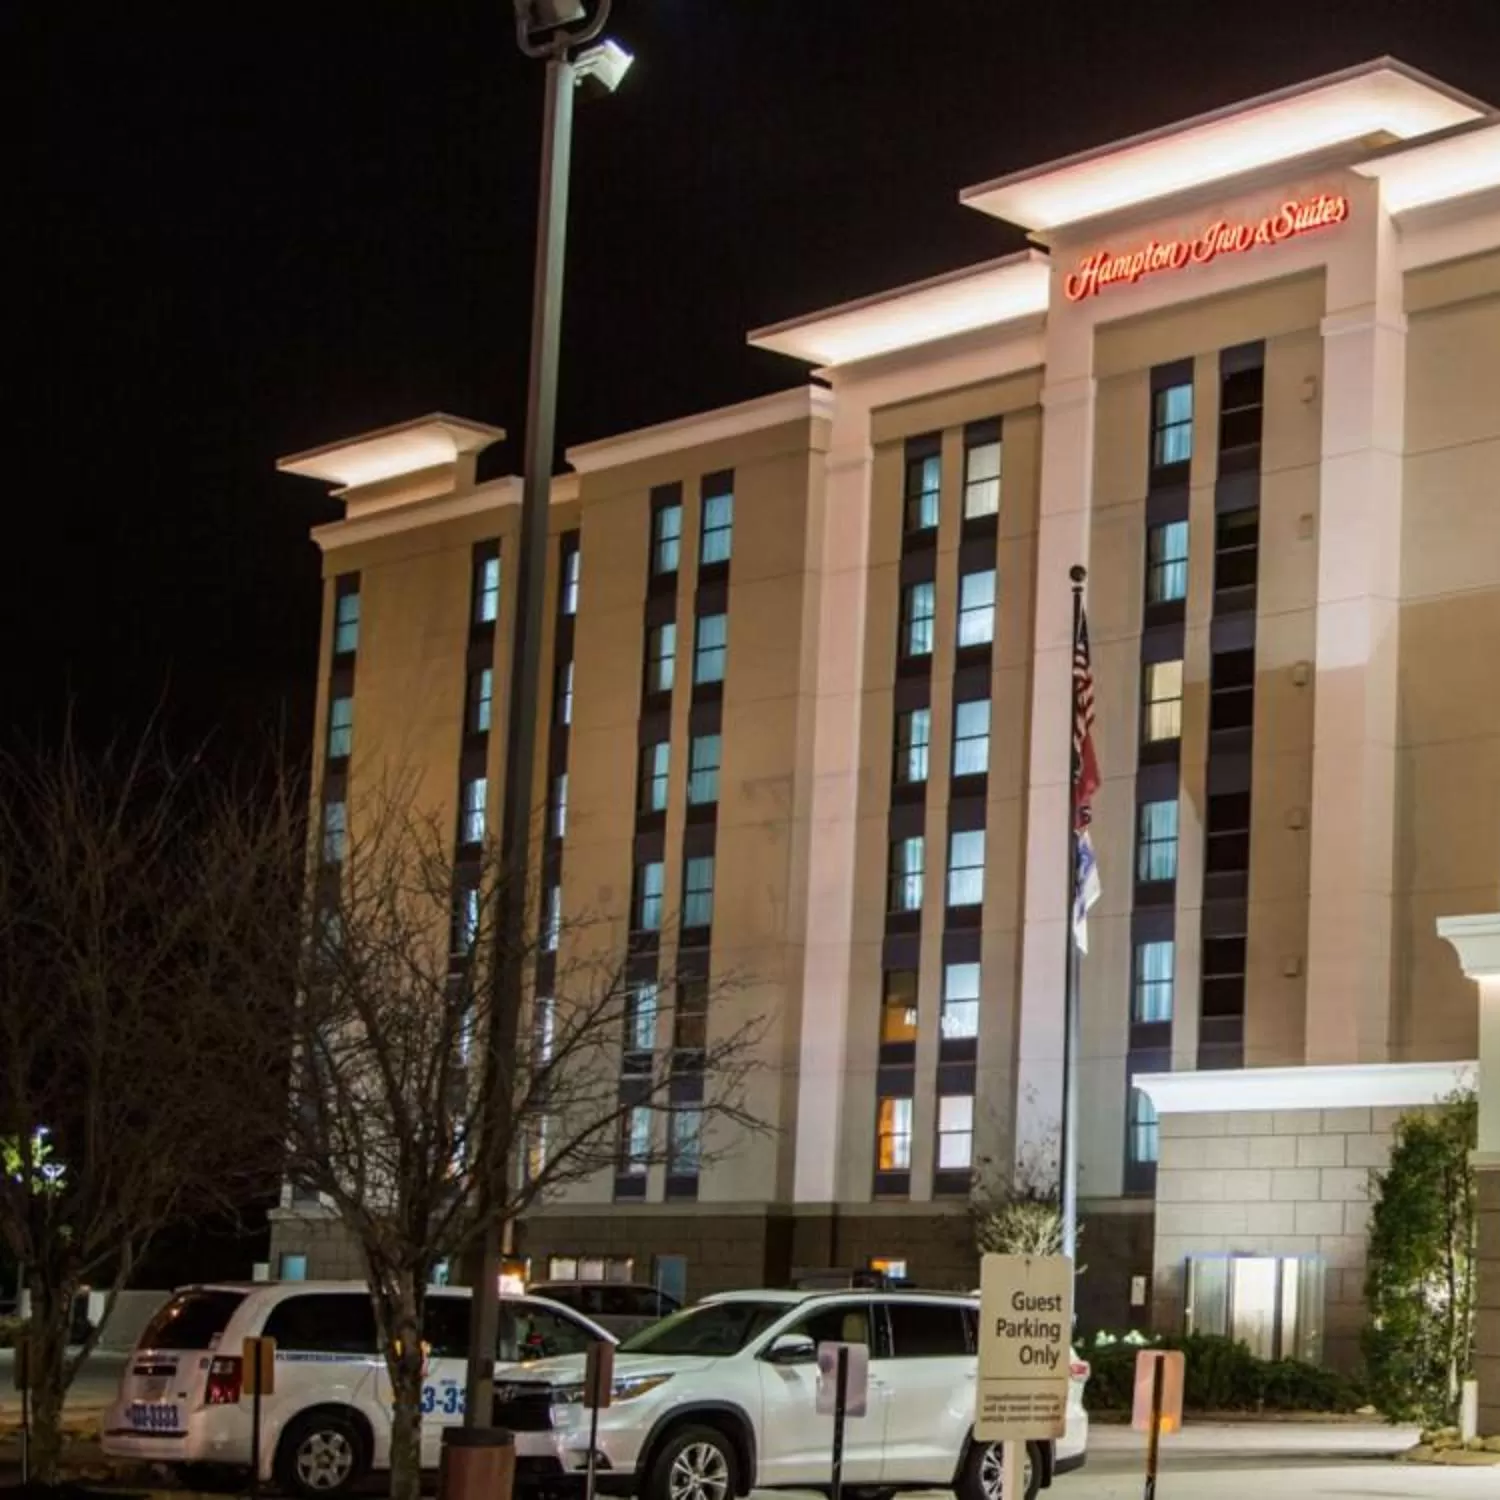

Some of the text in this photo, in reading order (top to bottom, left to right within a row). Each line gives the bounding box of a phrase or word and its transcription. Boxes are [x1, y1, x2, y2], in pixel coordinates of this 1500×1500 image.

[1065, 195, 1349, 300] Hampton Inn & Suites
[1011, 1291, 1062, 1313] Guest
[996, 1318, 1061, 1344] Parking
[1019, 1344, 1060, 1370] Only
